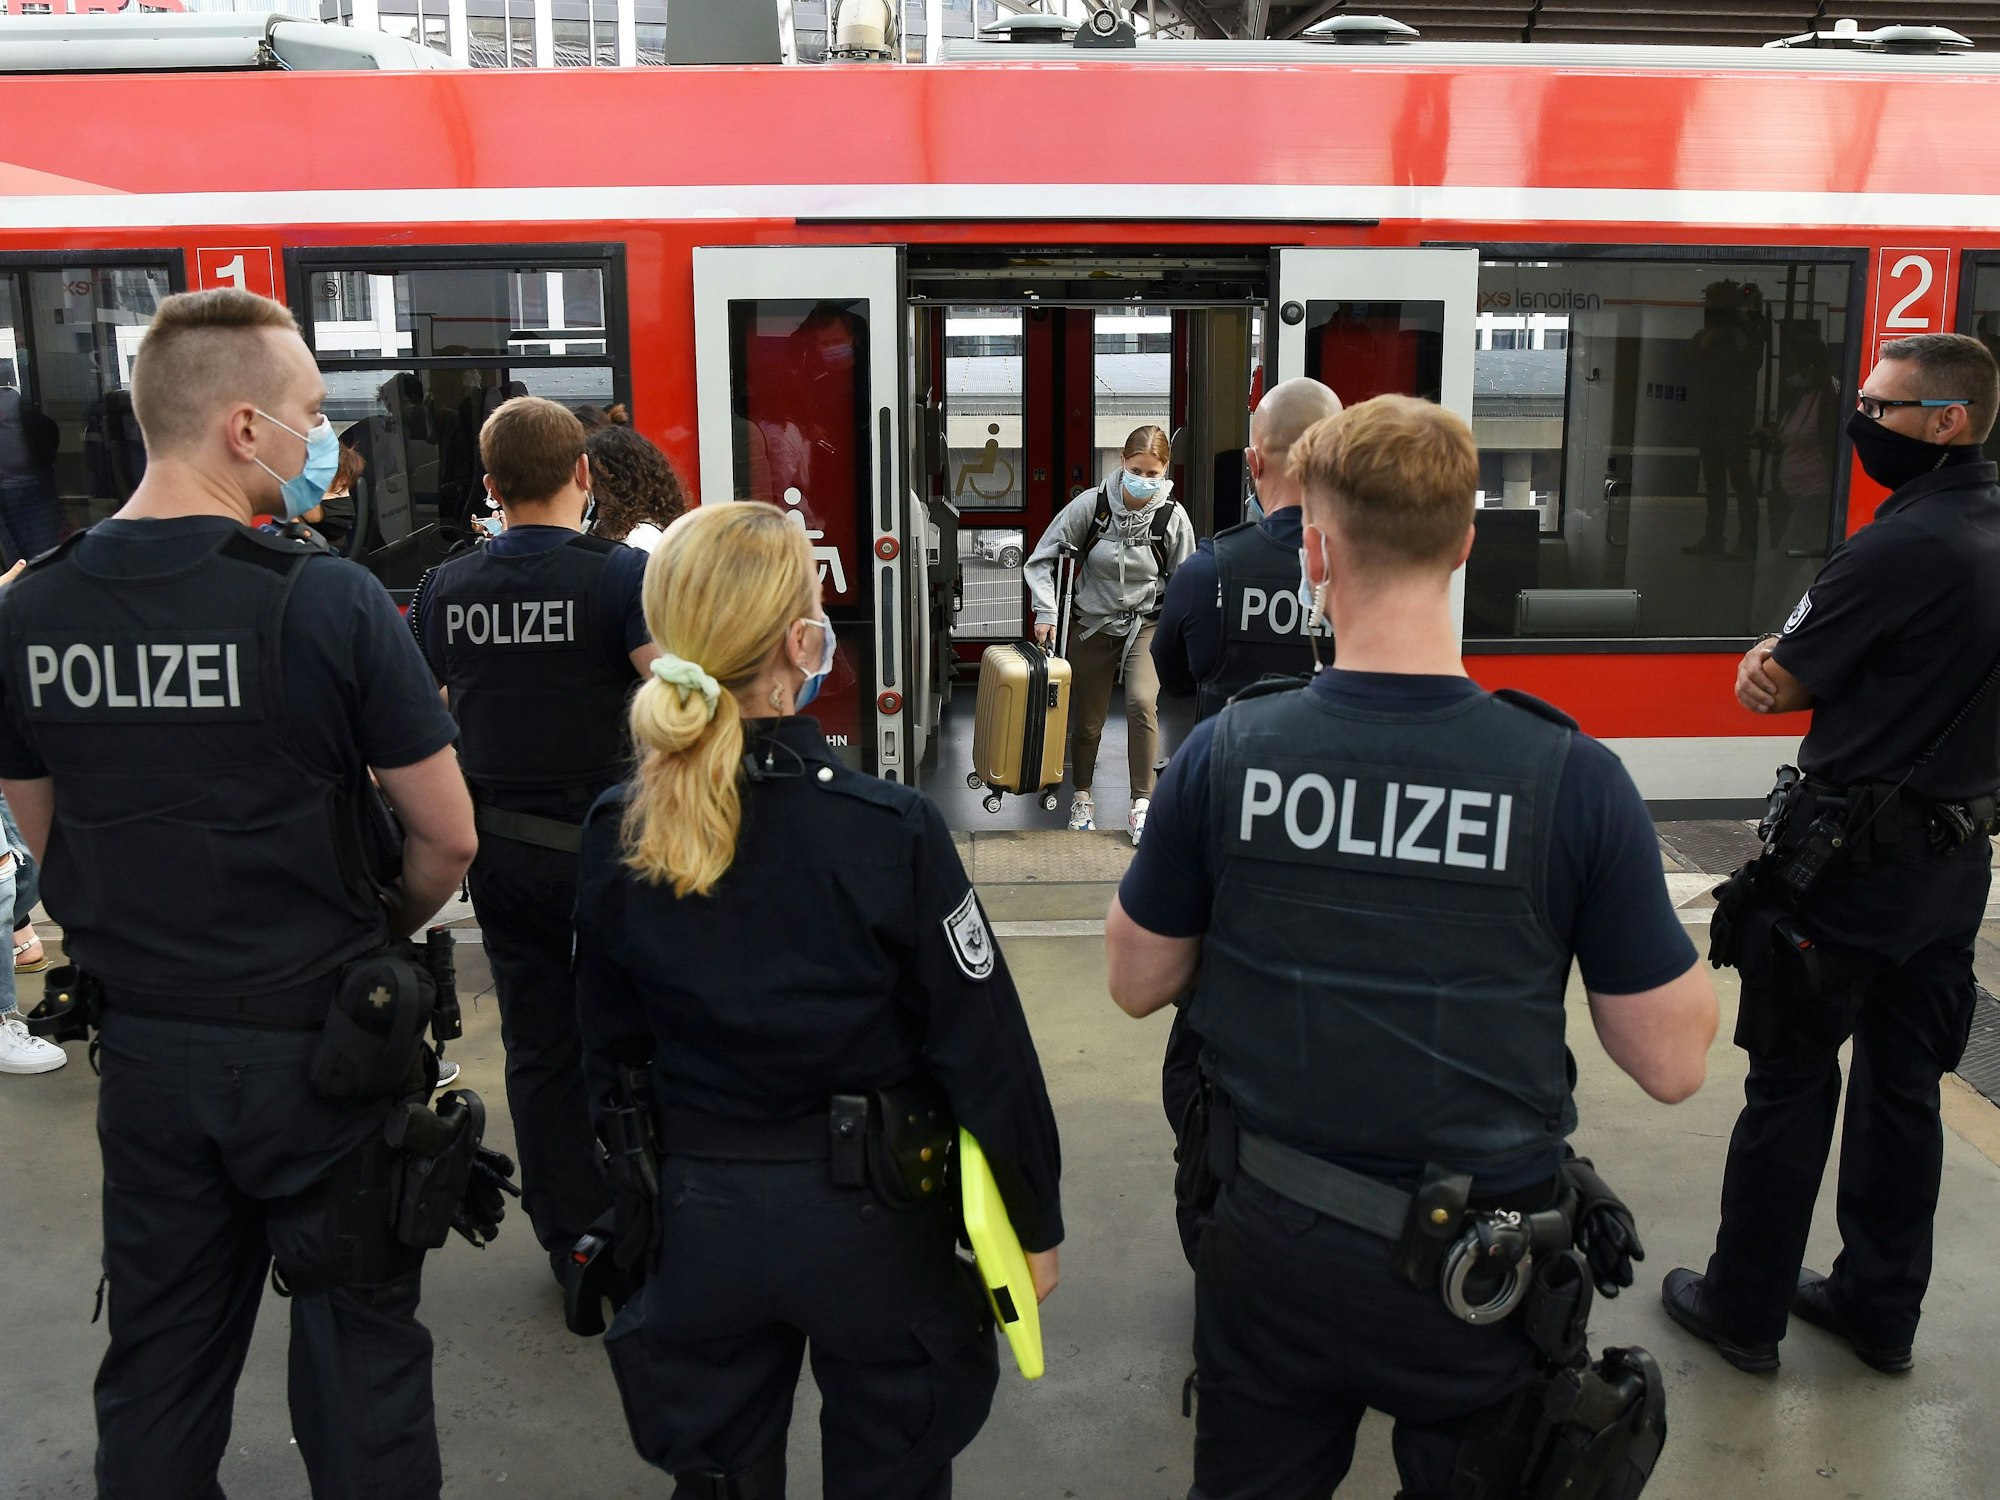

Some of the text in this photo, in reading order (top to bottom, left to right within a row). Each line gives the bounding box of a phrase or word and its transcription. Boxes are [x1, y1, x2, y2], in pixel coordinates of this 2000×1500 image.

[216, 255, 246, 291] 1
[1886, 255, 1933, 328] 2
[446, 600, 575, 645] POLIZEI
[1240, 587, 1333, 637] POL
[27, 643, 241, 708] POLIZEI
[1240, 768, 1512, 871] POLIZEI
